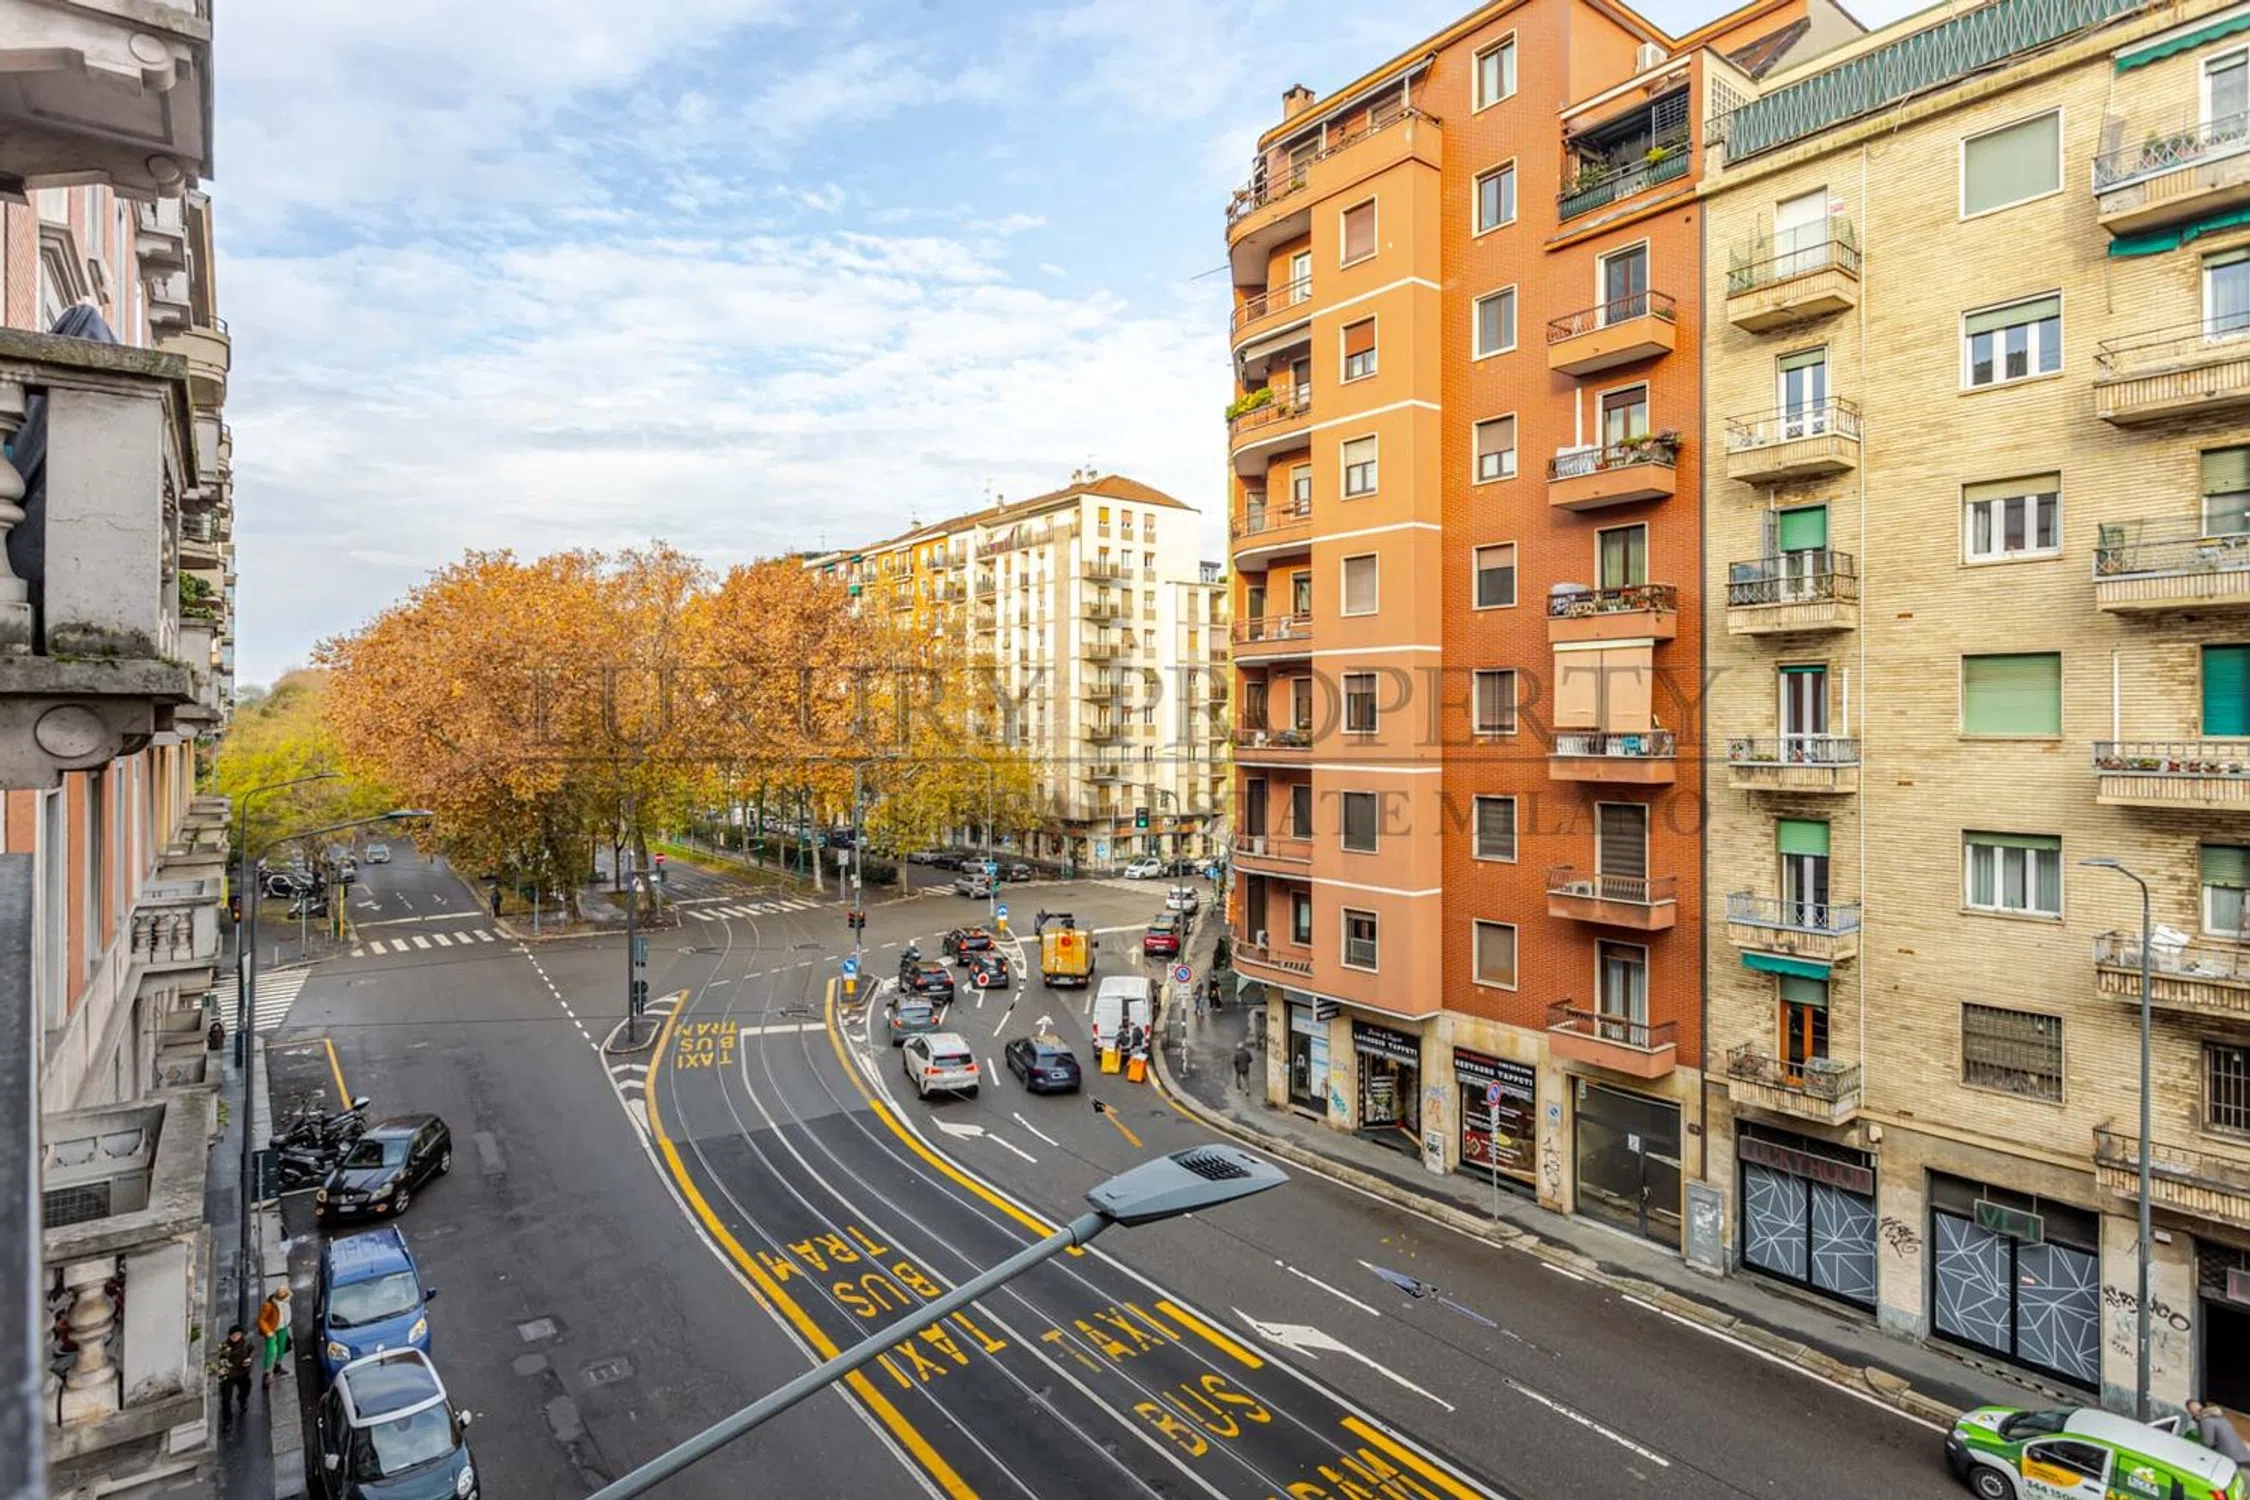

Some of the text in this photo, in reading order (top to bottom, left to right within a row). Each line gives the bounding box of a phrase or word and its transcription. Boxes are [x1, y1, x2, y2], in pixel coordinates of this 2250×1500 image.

[677, 1051, 733, 1069] TAXI
[680, 1036, 735, 1053] BUS
[756, 1225, 889, 1282] TRAM
[832, 1261, 942, 1318] BUS
[875, 1310, 1008, 1389] TAXI
[1040, 1301, 1182, 1374] TAXI
[1133, 1373, 1273, 1458] BUS
